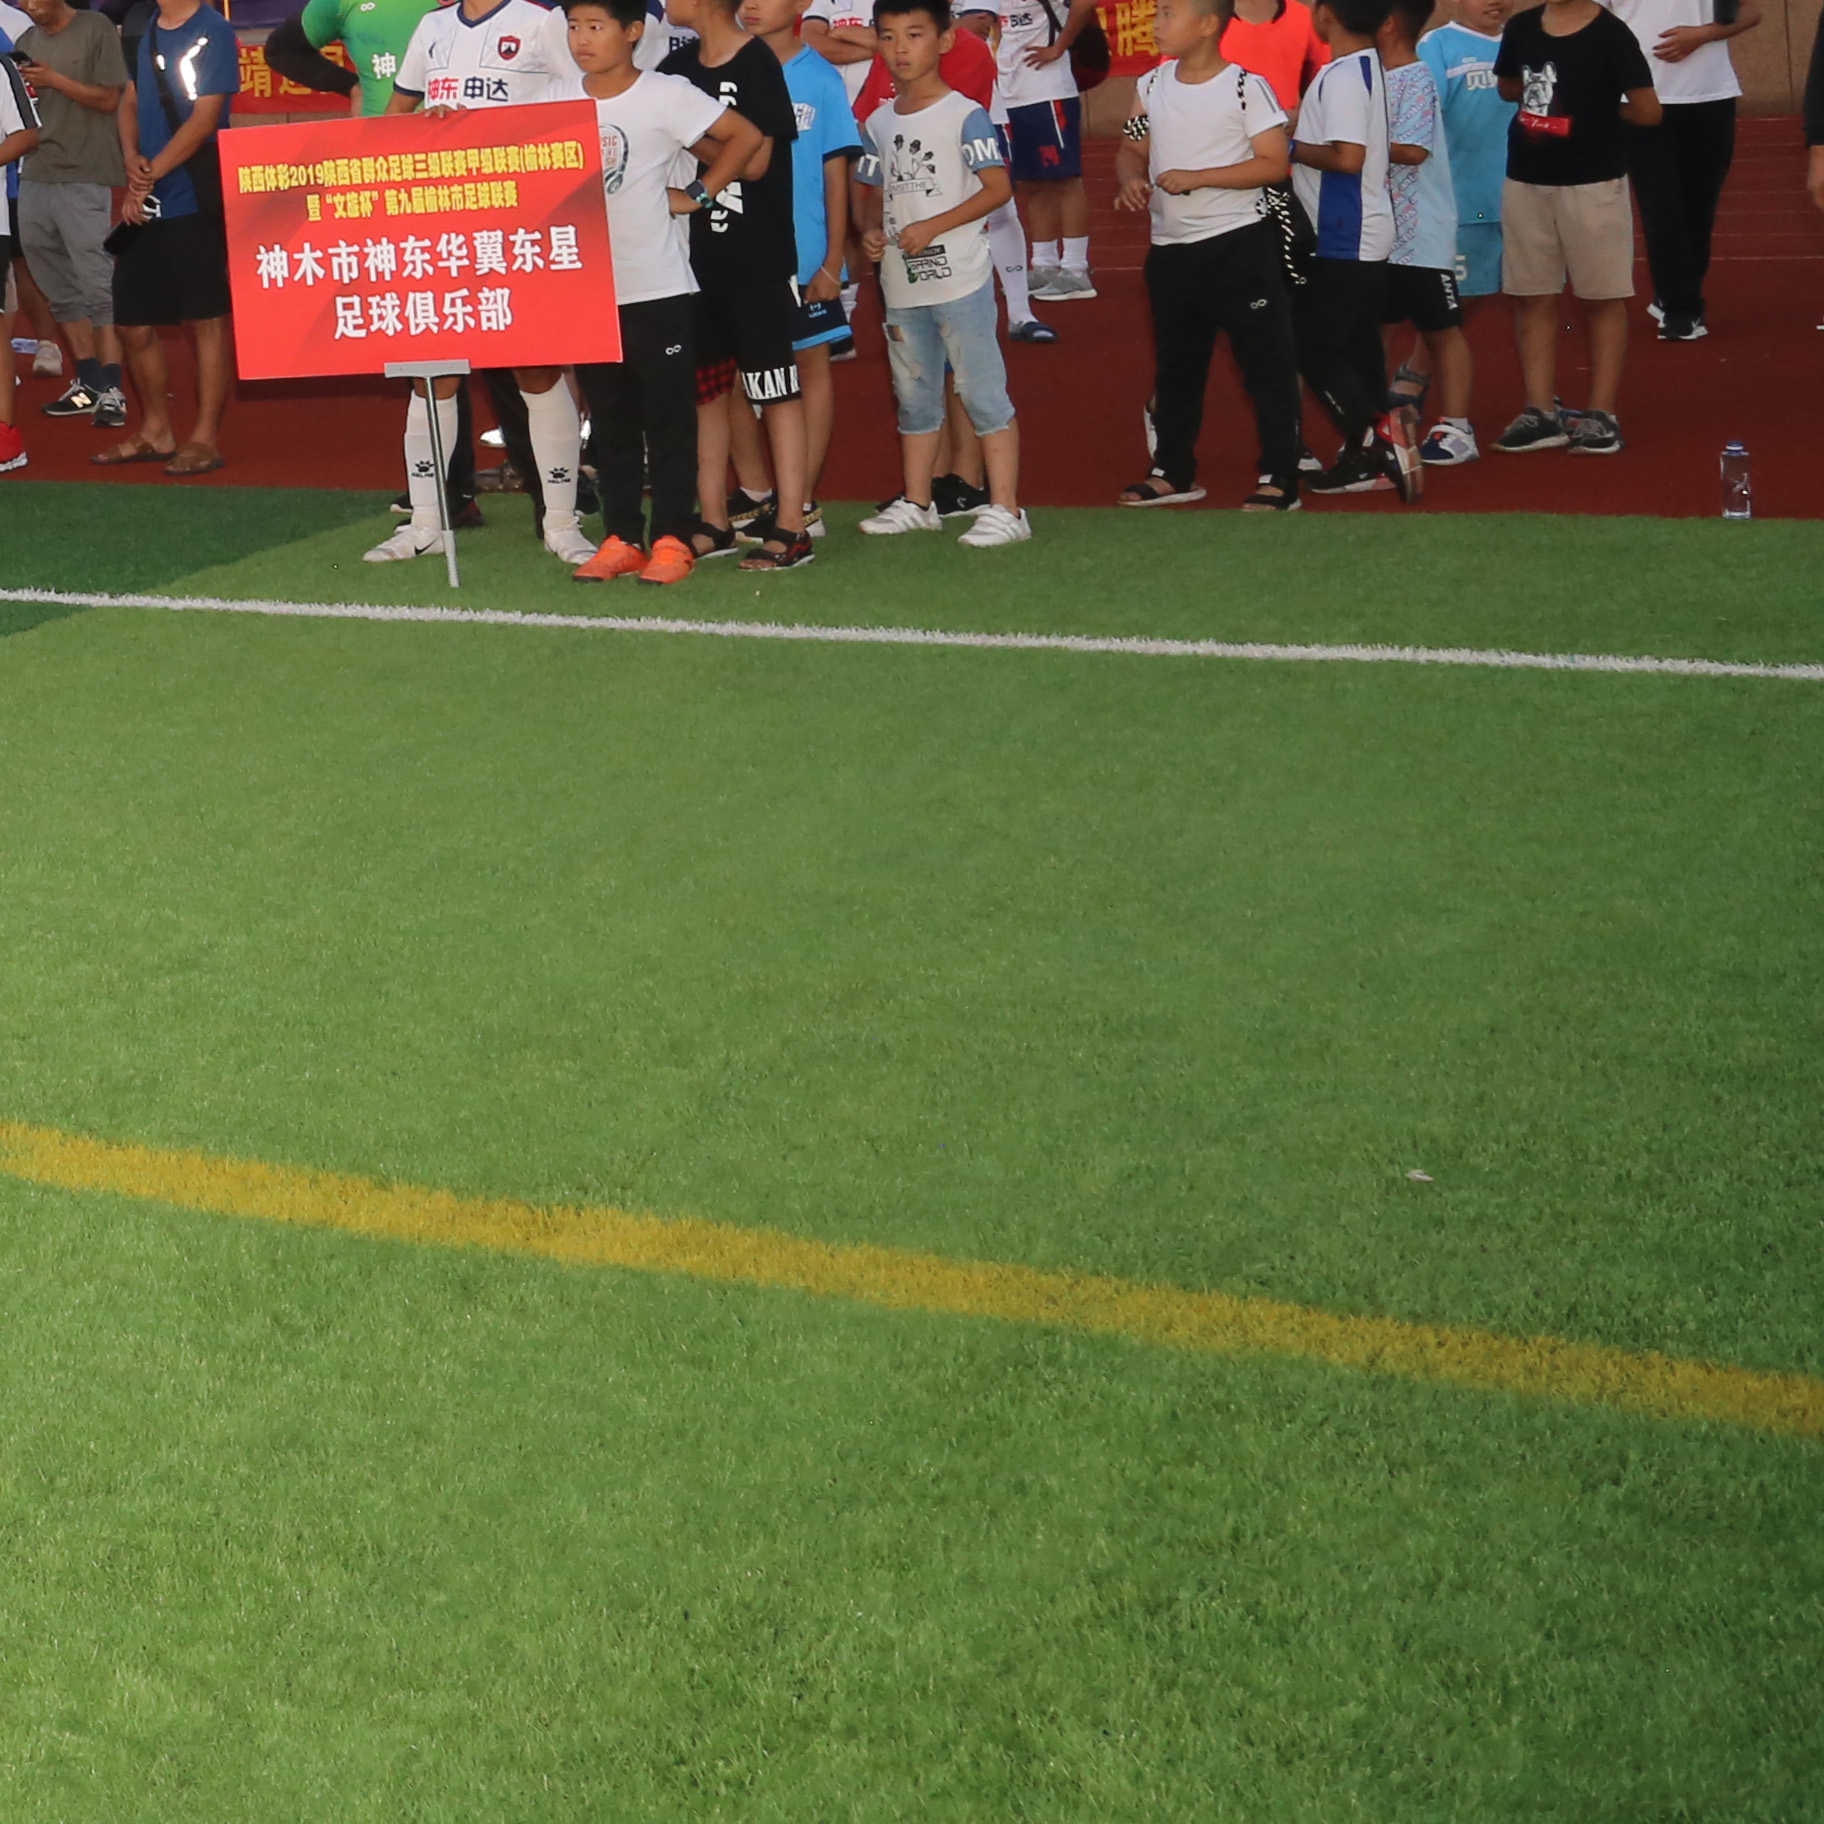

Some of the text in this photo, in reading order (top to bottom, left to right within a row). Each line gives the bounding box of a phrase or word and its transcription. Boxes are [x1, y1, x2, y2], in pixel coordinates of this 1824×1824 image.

[371, 52, 397, 79] 神
[463, 76, 509, 102] 申达
[255, 224, 584, 289] 神木市神东华翼东星
[333, 286, 513, 341] 足球俱乐部
